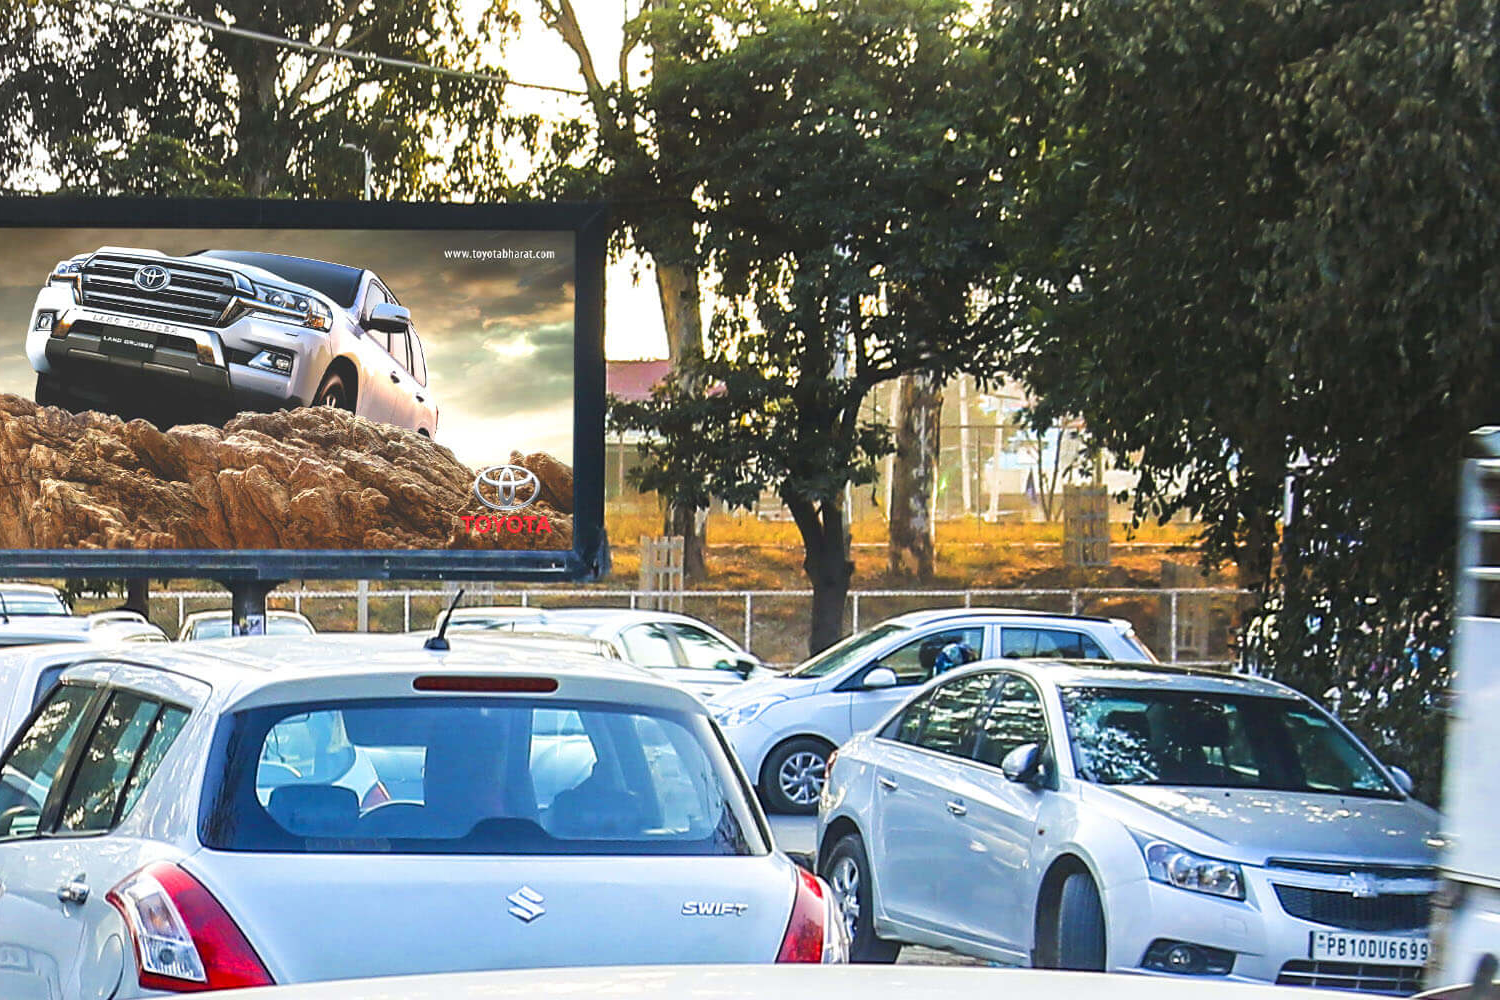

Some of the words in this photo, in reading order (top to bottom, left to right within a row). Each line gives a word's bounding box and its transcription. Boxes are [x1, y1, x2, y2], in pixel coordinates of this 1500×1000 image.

[444, 248, 555, 260] www.toyotabharat.com
[103, 335, 122, 343] LAND
[461, 515, 552, 534] TOYOTA
[681, 901, 749, 916] SWIFT
[1327, 937, 1428, 960] PB10DU6699
